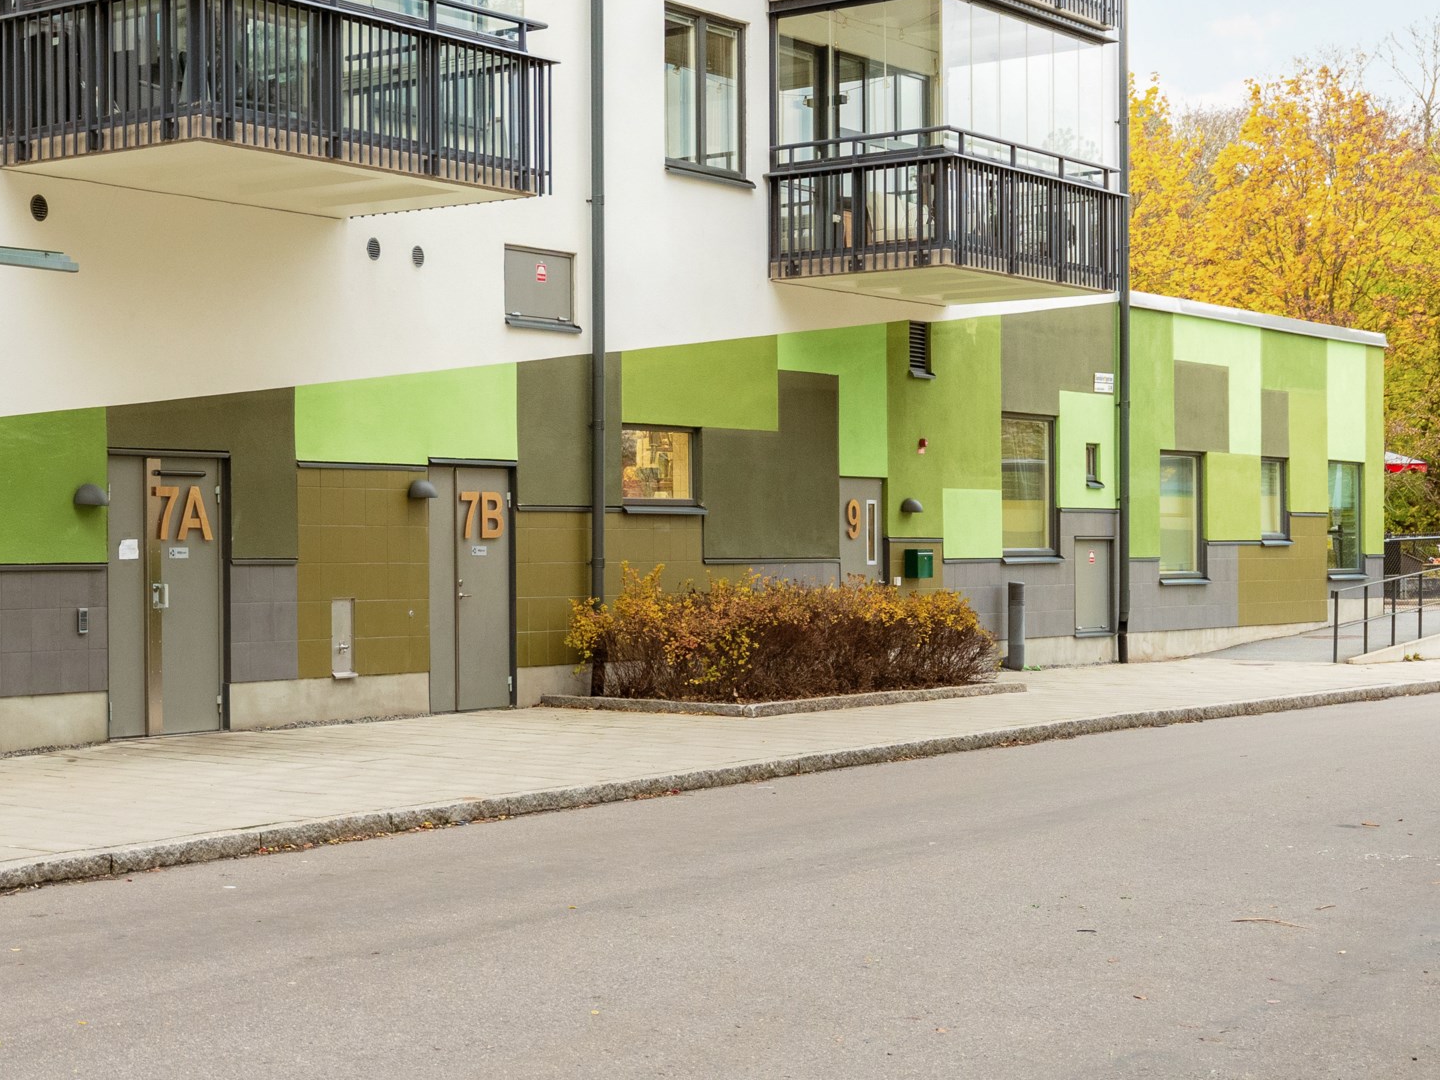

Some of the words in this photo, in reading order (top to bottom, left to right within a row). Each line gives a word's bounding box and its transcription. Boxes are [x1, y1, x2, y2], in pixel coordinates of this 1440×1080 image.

[151, 485, 214, 540] 7A
[460, 491, 504, 539] 7B
[846, 498, 861, 539] 9
